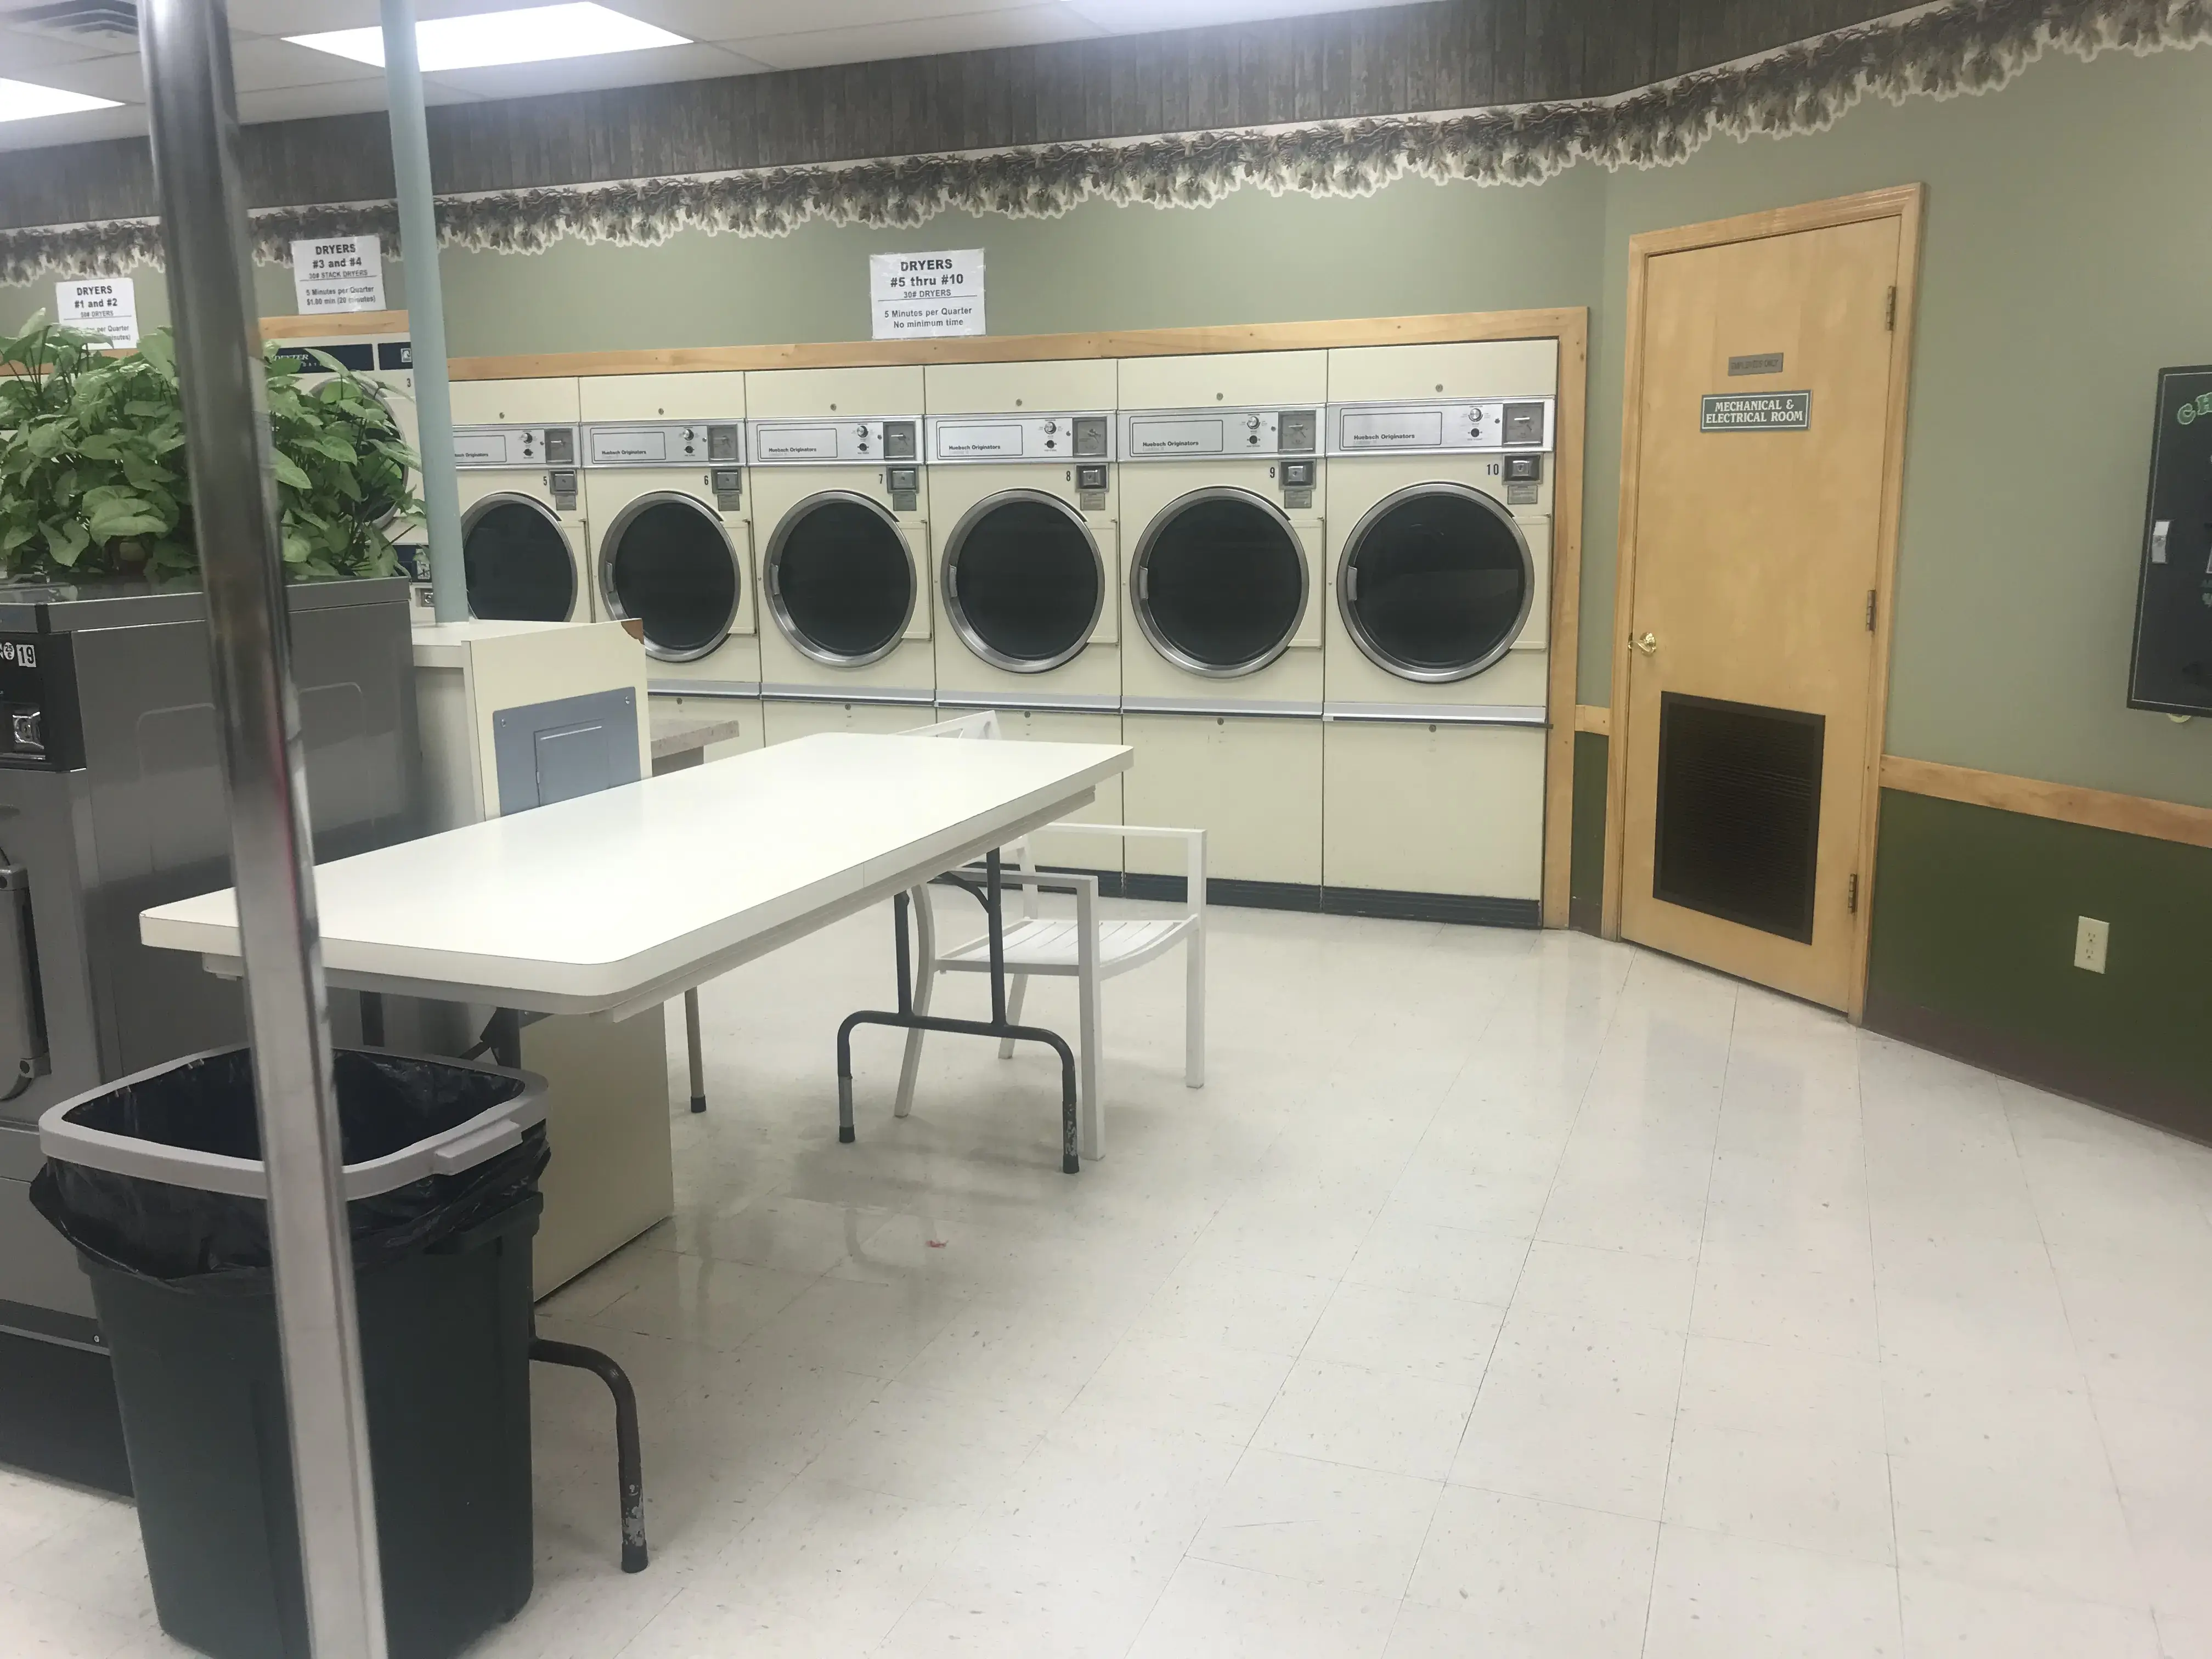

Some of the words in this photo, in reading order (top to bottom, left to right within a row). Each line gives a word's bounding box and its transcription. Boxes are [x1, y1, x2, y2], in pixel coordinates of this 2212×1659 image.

[315, 244, 356, 255] DRYERS
[313, 259, 325, 269] #3
[328, 258, 346, 268] and
[349, 257, 362, 267] #4
[900, 258, 953, 272] DRYERS
[890, 276, 905, 287] #5
[910, 276, 936, 286] thru
[941, 274, 963, 285] #10
[77, 286, 112, 296] DRYERS
[919, 289, 951, 298] DRYERS
[75, 300, 84, 308] #1
[88, 299, 104, 307] and
[107, 298, 117, 307] #2
[892, 309, 923, 318] Minutes
[926, 309, 939, 318] per
[941, 307, 972, 315] Quarter
[907, 319, 943, 328] minimum
[407, 378, 411, 387] 3
[1715, 399, 1782, 412] MECHANICAL
[1786, 399, 1795, 409] &
[1706, 412, 1767, 424] ELECTRICAL
[1770, 410, 1803, 422] ROOM
[1269, 467, 1275, 478] 9
[1486, 463, 1499, 476] 10
[543, 476, 548, 486] 5
[704, 475, 709, 486] 6
[878, 474, 883, 484] 7
[1066, 470, 1071, 482] 8
[19, 647, 34, 664] 19
